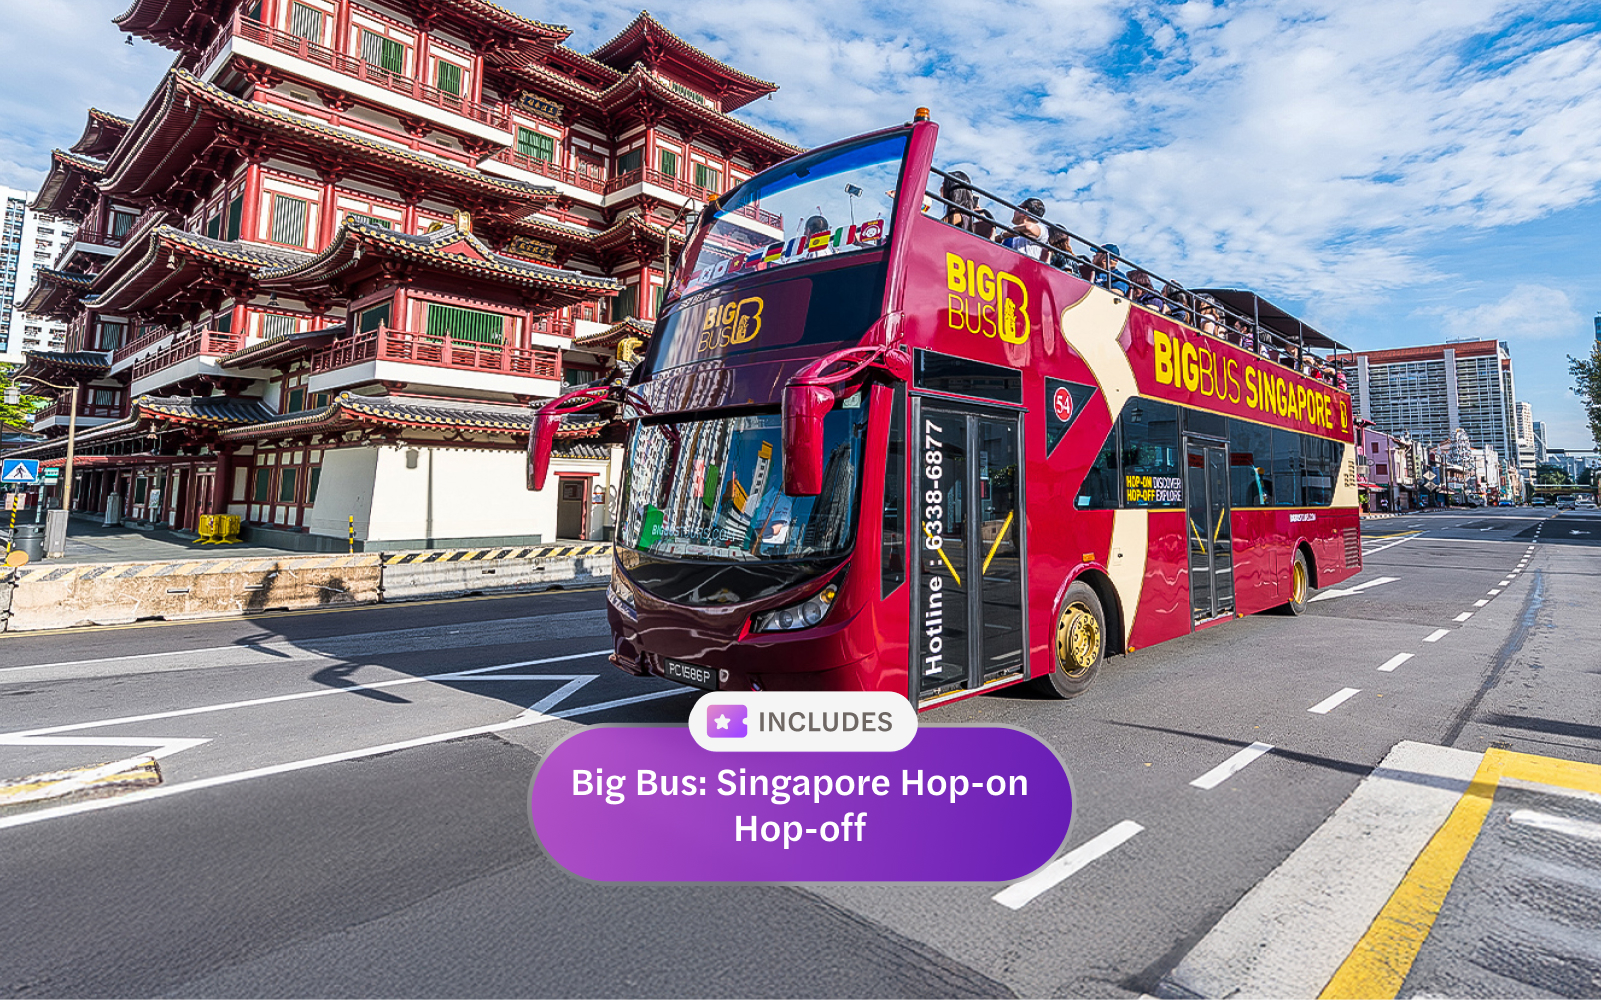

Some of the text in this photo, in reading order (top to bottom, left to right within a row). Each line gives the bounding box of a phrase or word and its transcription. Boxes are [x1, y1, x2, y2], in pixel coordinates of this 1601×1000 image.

[946, 252, 996, 302] BIG
[703, 301, 737, 331] BIG
[948, 293, 997, 338] BUS
[698, 326, 732, 352] BUS
[1056, 395, 1070, 414] 54
[1245, 365, 1333, 430] SINGAPORE
[926, 419, 943, 550] 6338-6877
[1126, 475, 1181, 489] HOP-ON DISCOVER
[1127, 489, 1182, 502] HOP-OFF EXPLORE
[926, 576, 943, 676] Hotline
[669, 662, 711, 683] PC1586P
